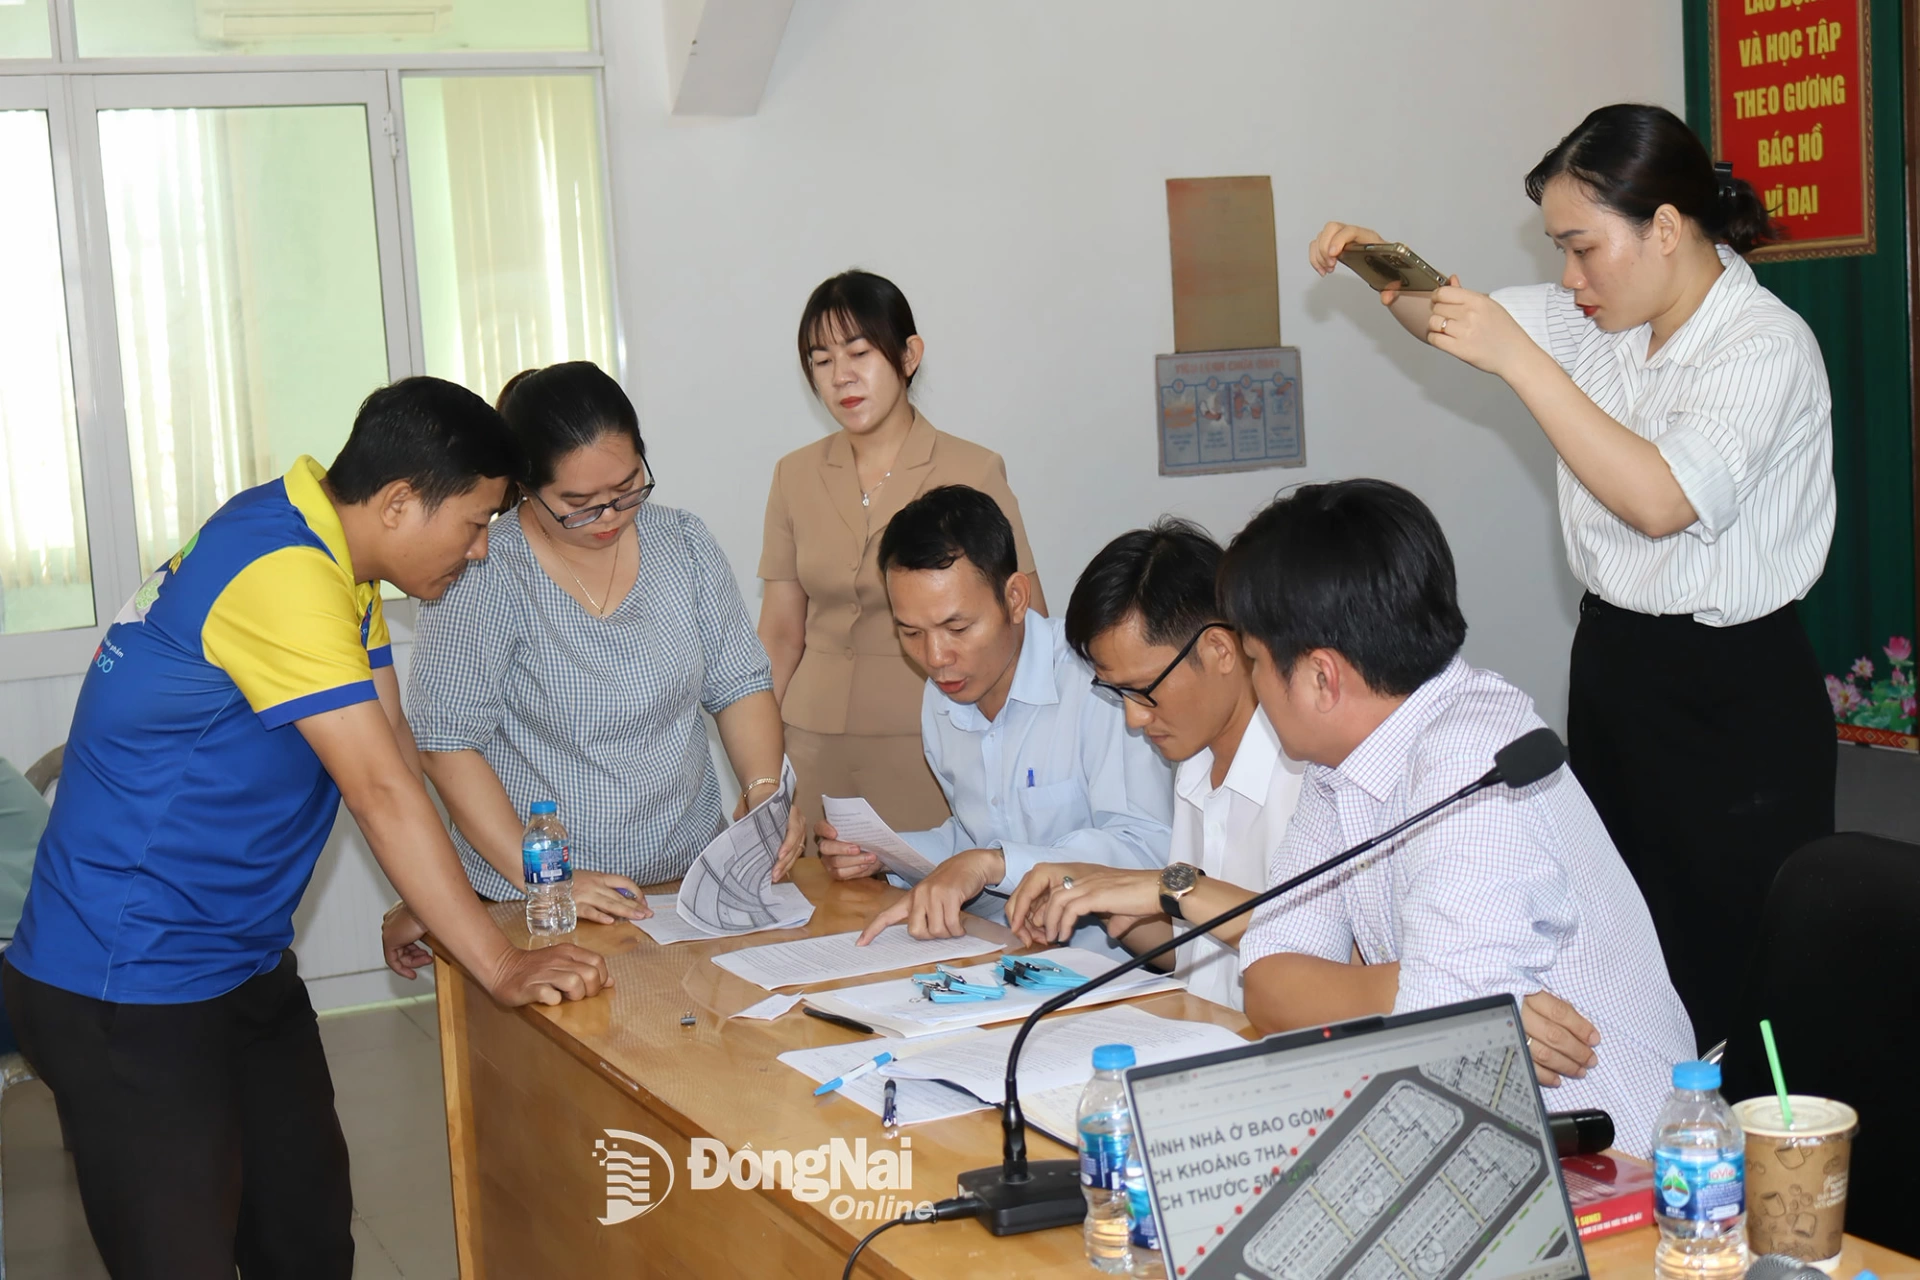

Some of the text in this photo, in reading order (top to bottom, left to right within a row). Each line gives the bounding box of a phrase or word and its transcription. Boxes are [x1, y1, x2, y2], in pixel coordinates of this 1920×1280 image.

[1739, 18, 1842, 67] VÀ HỌC TẬP
[1734, 73, 1846, 119] THEO GƯƠNG
[1758, 123, 1824, 167] BÁC HỒ
[1787, 185, 1819, 220] ĐẠI
[1248, 1116, 1284, 1138] BAO
[1254, 1143, 1290, 1163] 7HA
